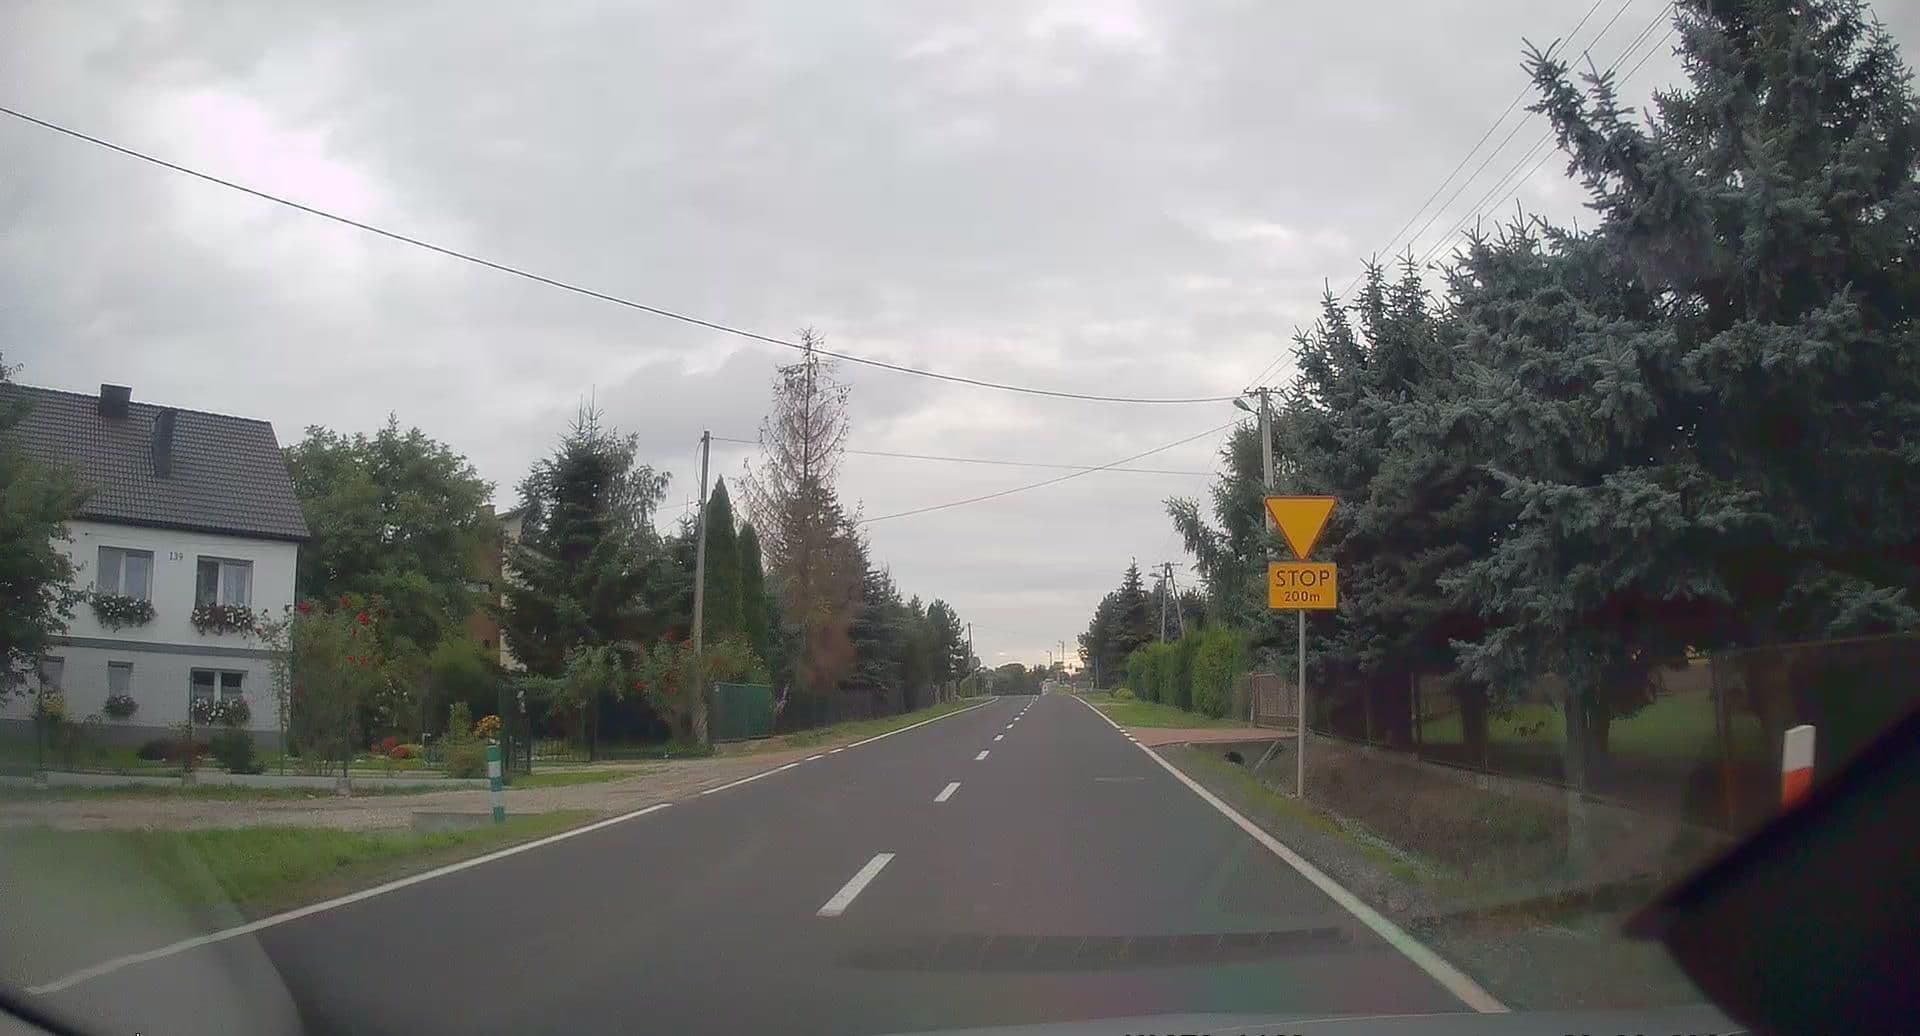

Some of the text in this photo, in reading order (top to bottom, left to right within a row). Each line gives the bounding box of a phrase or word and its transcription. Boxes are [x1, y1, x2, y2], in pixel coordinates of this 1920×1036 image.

[169, 551, 184, 561] 139
[1275, 569, 1330, 587] STOP
[1284, 591, 1320, 602] 200m
